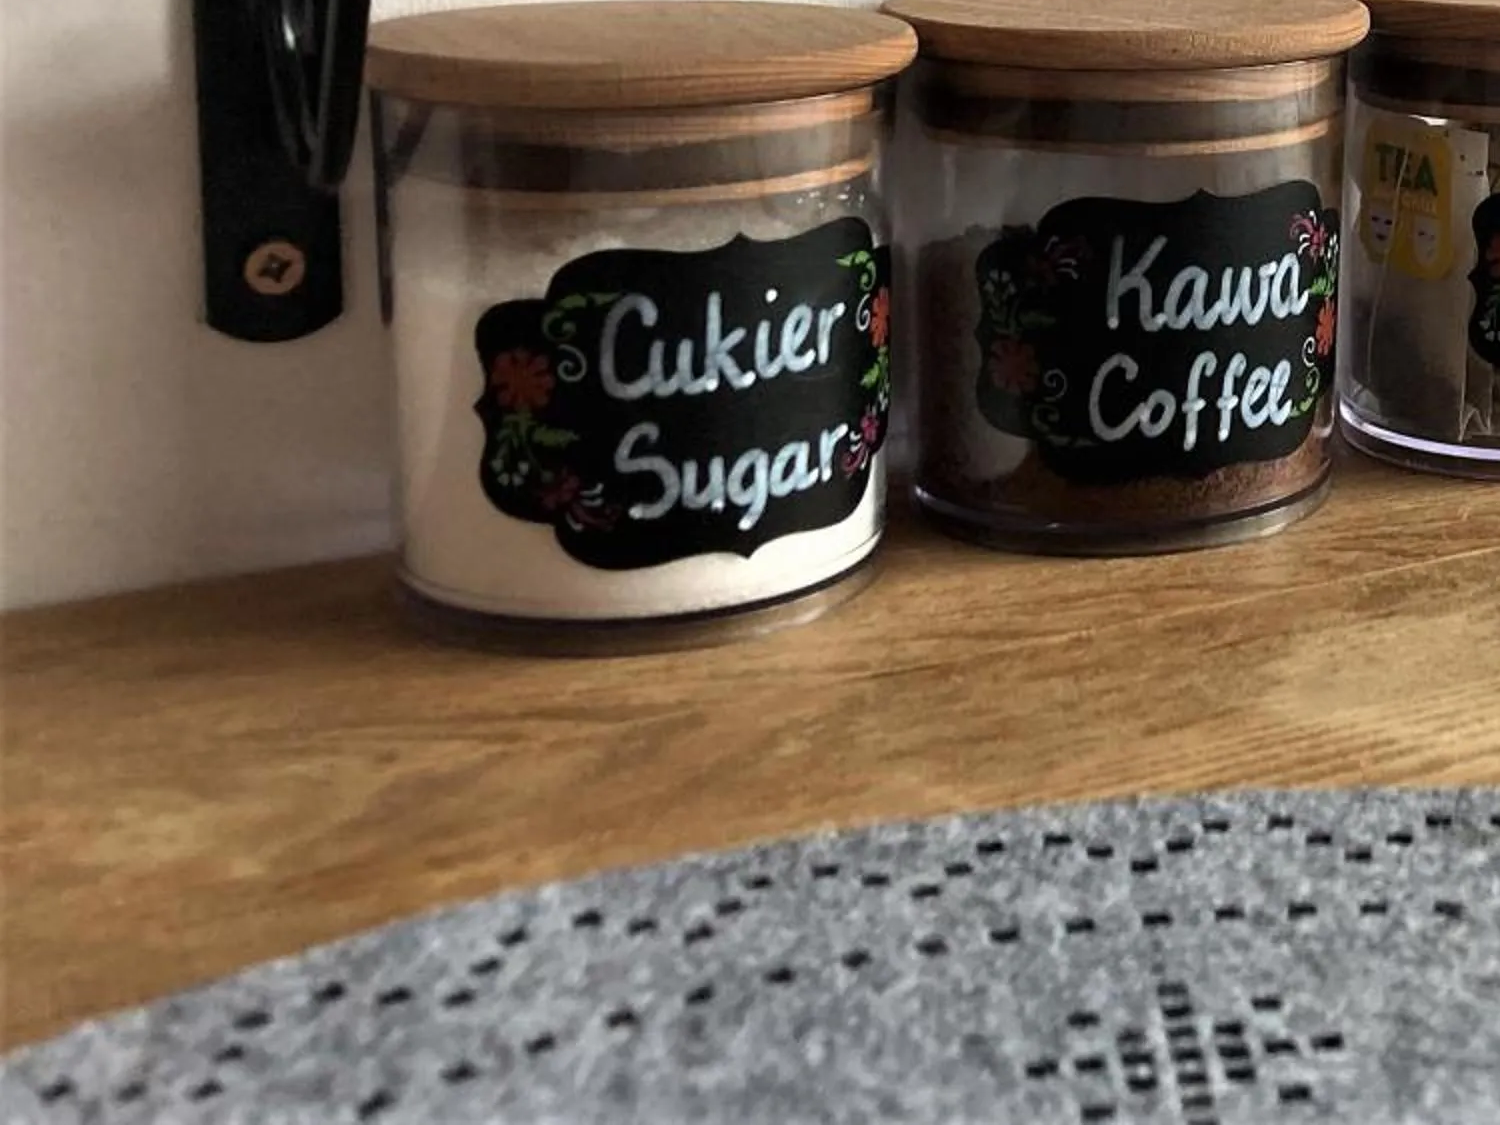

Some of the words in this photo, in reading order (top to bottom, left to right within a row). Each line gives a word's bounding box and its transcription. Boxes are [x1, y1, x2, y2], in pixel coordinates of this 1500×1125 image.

[1106, 233, 1310, 333] Kawa
[600, 287, 846, 401] Cukier
[1088, 350, 1293, 452] Coffee
[613, 421, 849, 532] Sugar
